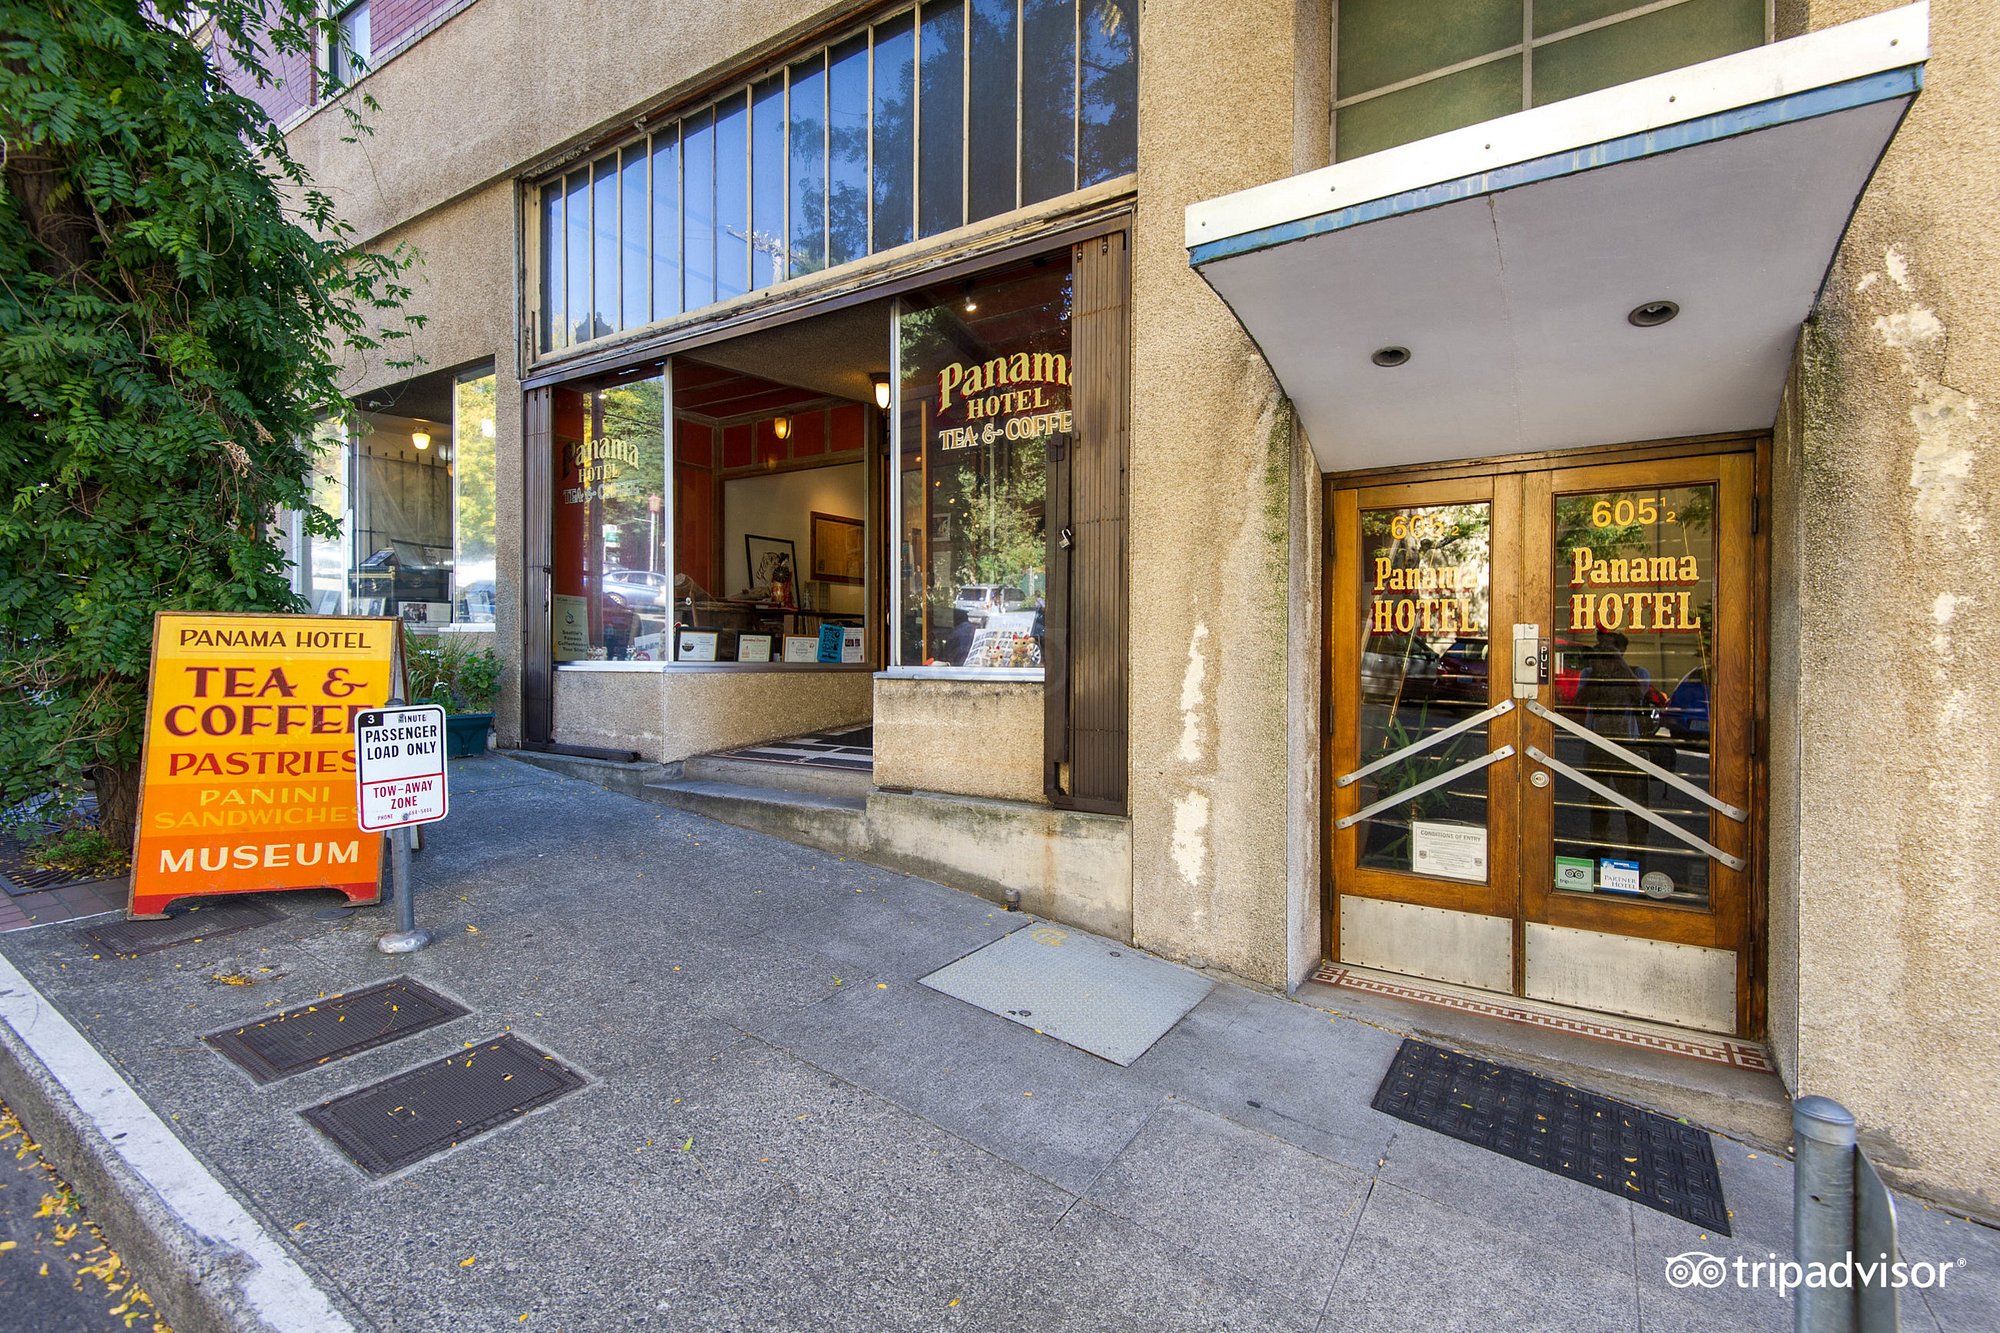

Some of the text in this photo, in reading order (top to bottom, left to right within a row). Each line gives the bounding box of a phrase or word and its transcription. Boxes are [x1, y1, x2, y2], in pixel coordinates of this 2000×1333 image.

[937, 352, 1072, 416] Panam
[966, 387, 1049, 420] HOTEL
[939, 410, 1072, 450] TEA & COFFE
[562, 437, 639, 481] Panama
[578, 463, 620, 483] HOTEL
[563, 487, 587, 504] TEA
[1373, 557, 1478, 594] Panama
[1570, 547, 1699, 588] Panama
[1372, 599, 1478, 635] HOTEL
[1569, 592, 1700, 633] HOTEL
[180, 629, 371, 649] PANAMA HOTEL
[1540, 646, 1548, 677] PULL
[184, 666, 368, 698] TEA &
[367, 714, 375, 724] 3
[365, 725, 437, 743] PASSENGER
[367, 741, 437, 760] LOAD ONLY
[169, 749, 356, 776] PASTRIES
[200, 786, 330, 806] PANINI
[373, 780, 433, 798] TOW-AWAY
[391, 796, 418, 810] ZONE
[154, 806, 358, 829] SANDWICHE
[1420, 829, 1454, 839] CONDITIONS
[159, 840, 360, 873] MUSEUM
[1604, 875, 1636, 883] PARTNER
[1611, 881, 1635, 889] HOTEL
